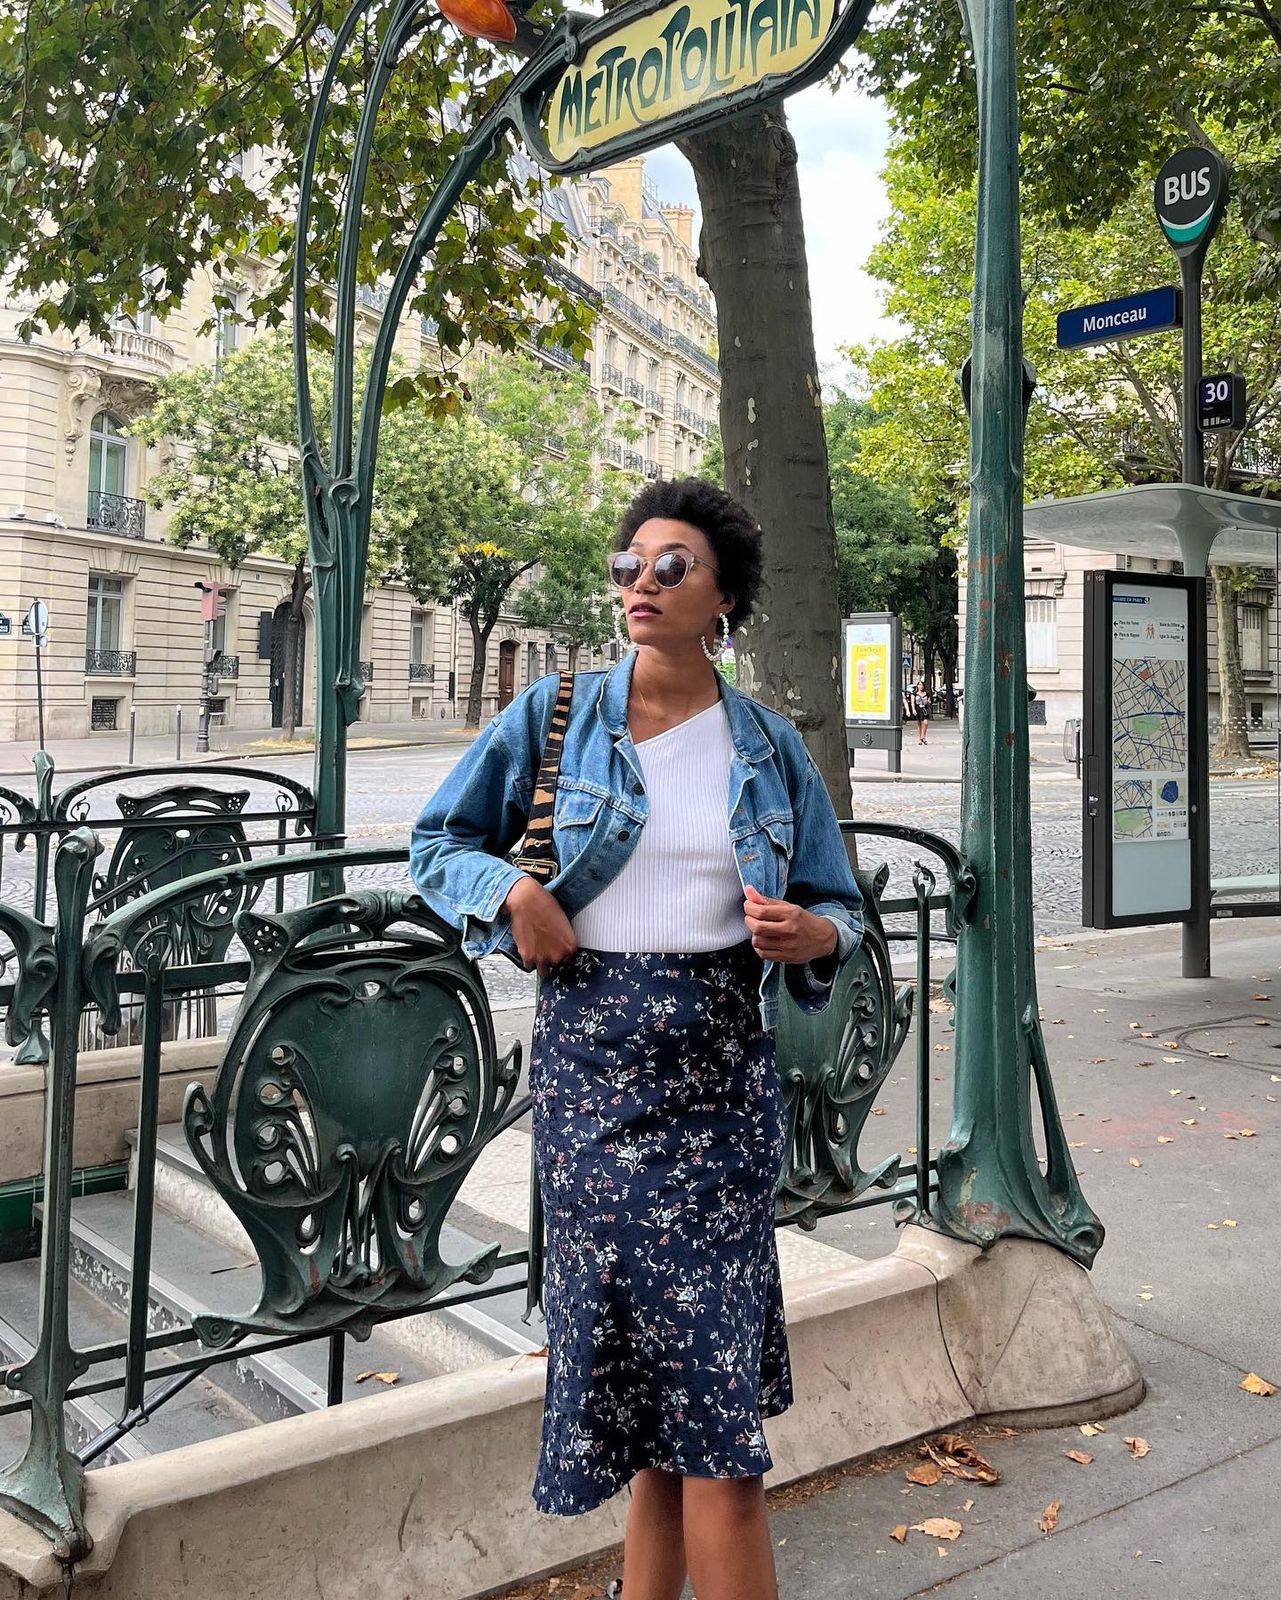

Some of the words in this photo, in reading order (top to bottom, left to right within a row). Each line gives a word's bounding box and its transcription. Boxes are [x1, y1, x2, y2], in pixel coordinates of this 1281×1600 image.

[558, 0, 821, 144] METROPOLITAIN
[1164, 167, 1210, 205] BUS
[1083, 307, 1147, 333] Monceau
[1205, 380, 1229, 403] 30
